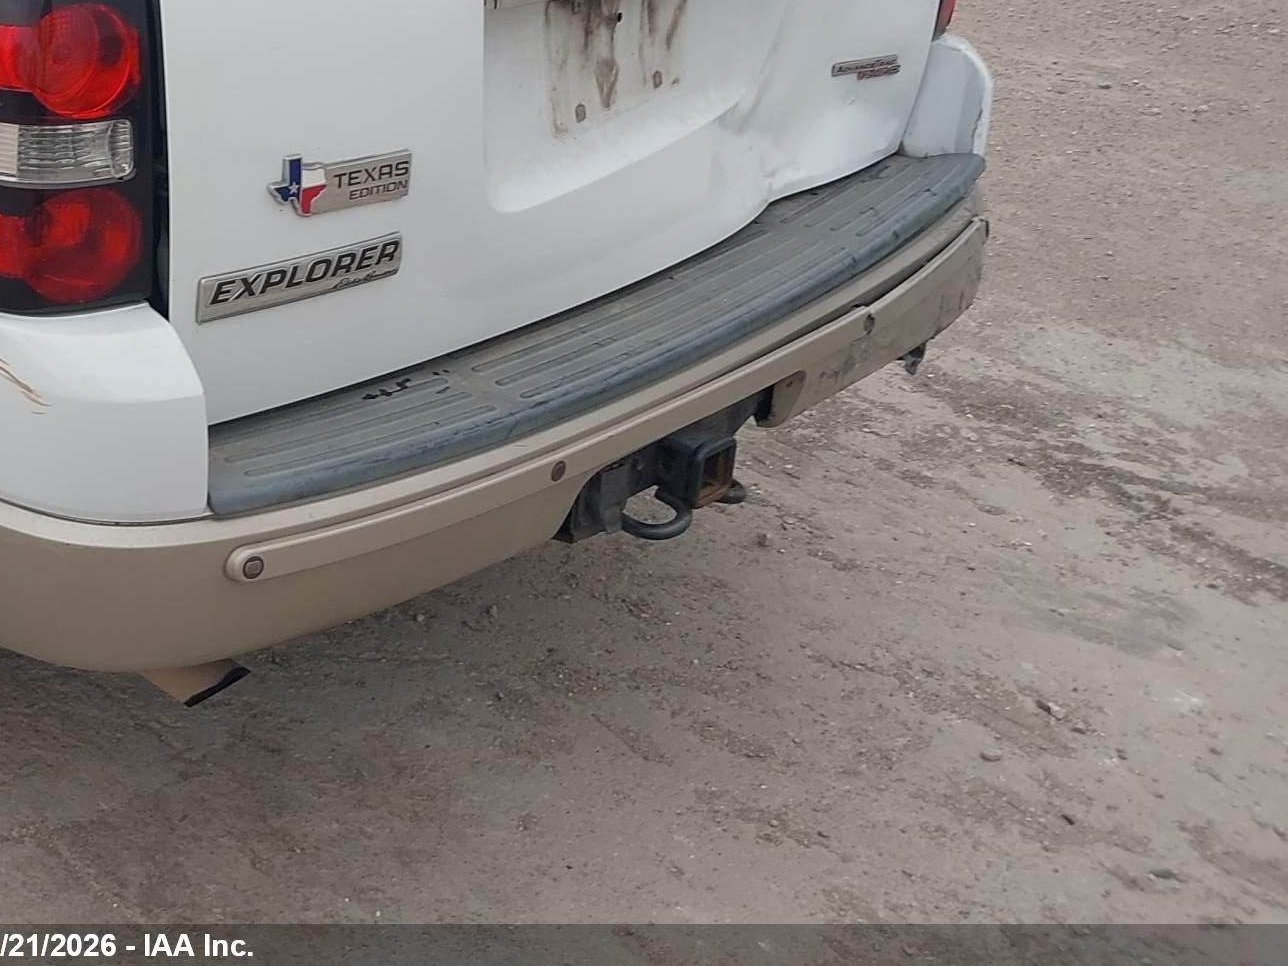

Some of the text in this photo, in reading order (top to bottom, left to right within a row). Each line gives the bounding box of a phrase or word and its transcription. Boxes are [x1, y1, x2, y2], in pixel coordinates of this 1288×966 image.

[333, 160, 410, 189] TEXAS
[348, 179, 409, 201] EDITION
[209, 240, 401, 306] EXPLORER
